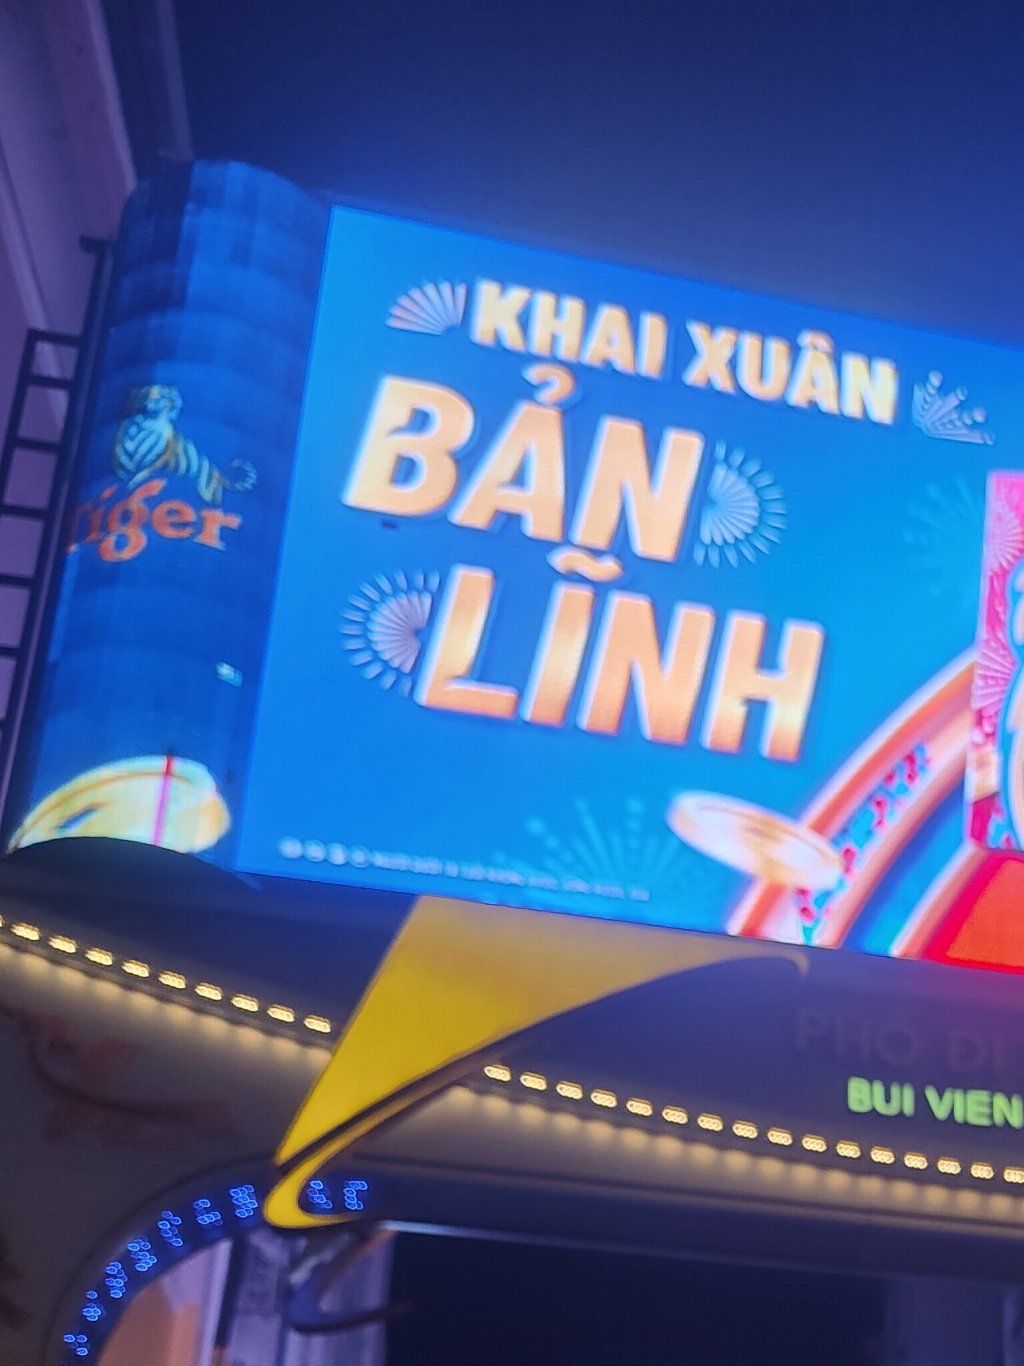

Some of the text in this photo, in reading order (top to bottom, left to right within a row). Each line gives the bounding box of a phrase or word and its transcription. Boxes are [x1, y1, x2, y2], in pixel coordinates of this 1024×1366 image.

[469, 277, 899, 424] KHAI XUÂN
[341, 363, 704, 563] BẢN
[412, 546, 825, 764] LĨNH
[846, 1075, 915, 1117] BUI
[924, 1084, 1024, 1131] VIEN
